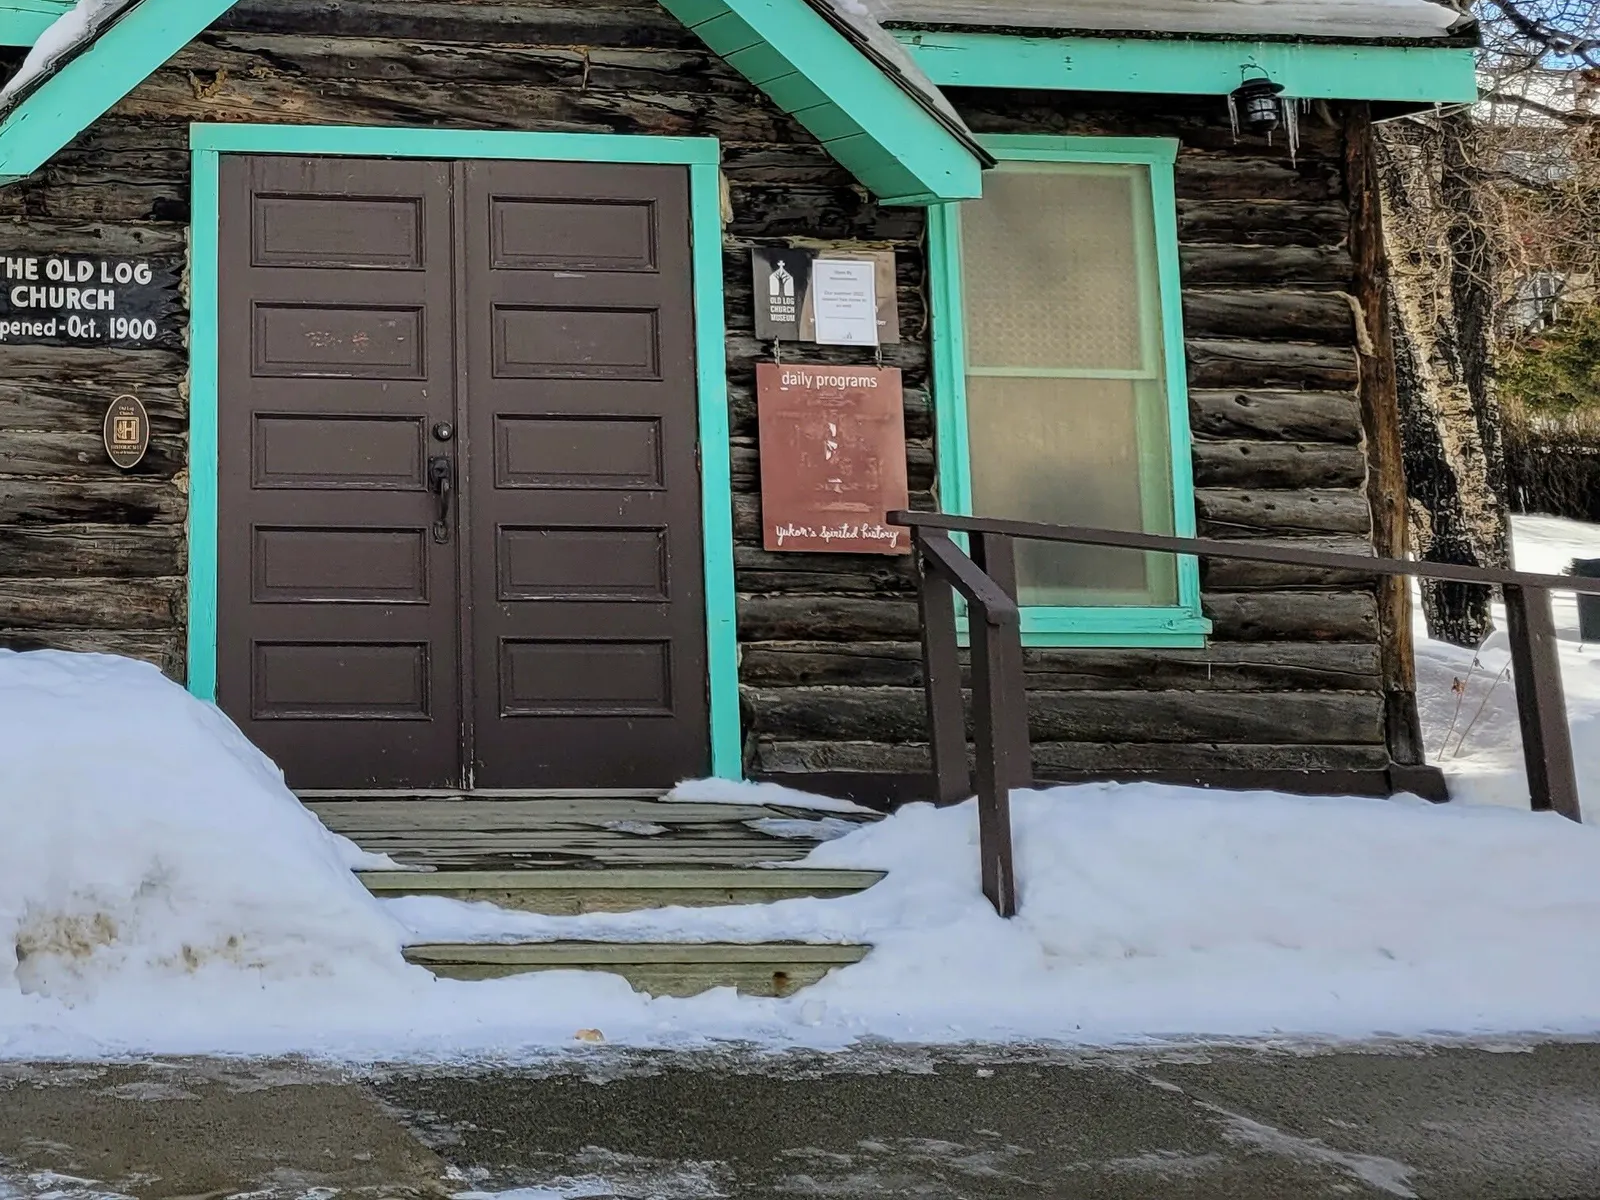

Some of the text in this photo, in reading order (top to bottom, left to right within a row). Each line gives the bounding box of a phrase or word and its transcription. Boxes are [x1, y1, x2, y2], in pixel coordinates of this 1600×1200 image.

[45, 258, 95, 283] OLD
[101, 261, 153, 286] LOG
[10, 286, 115, 311] CHURCH
[769, 296, 795, 305] OLD LOG
[770, 305, 795, 314] CHURCH
[770, 314, 796, 322] MUSEUM
[109, 317, 158, 341] 1900
[781, 371, 878, 390] daily programs
[860, 522, 900, 548] history
